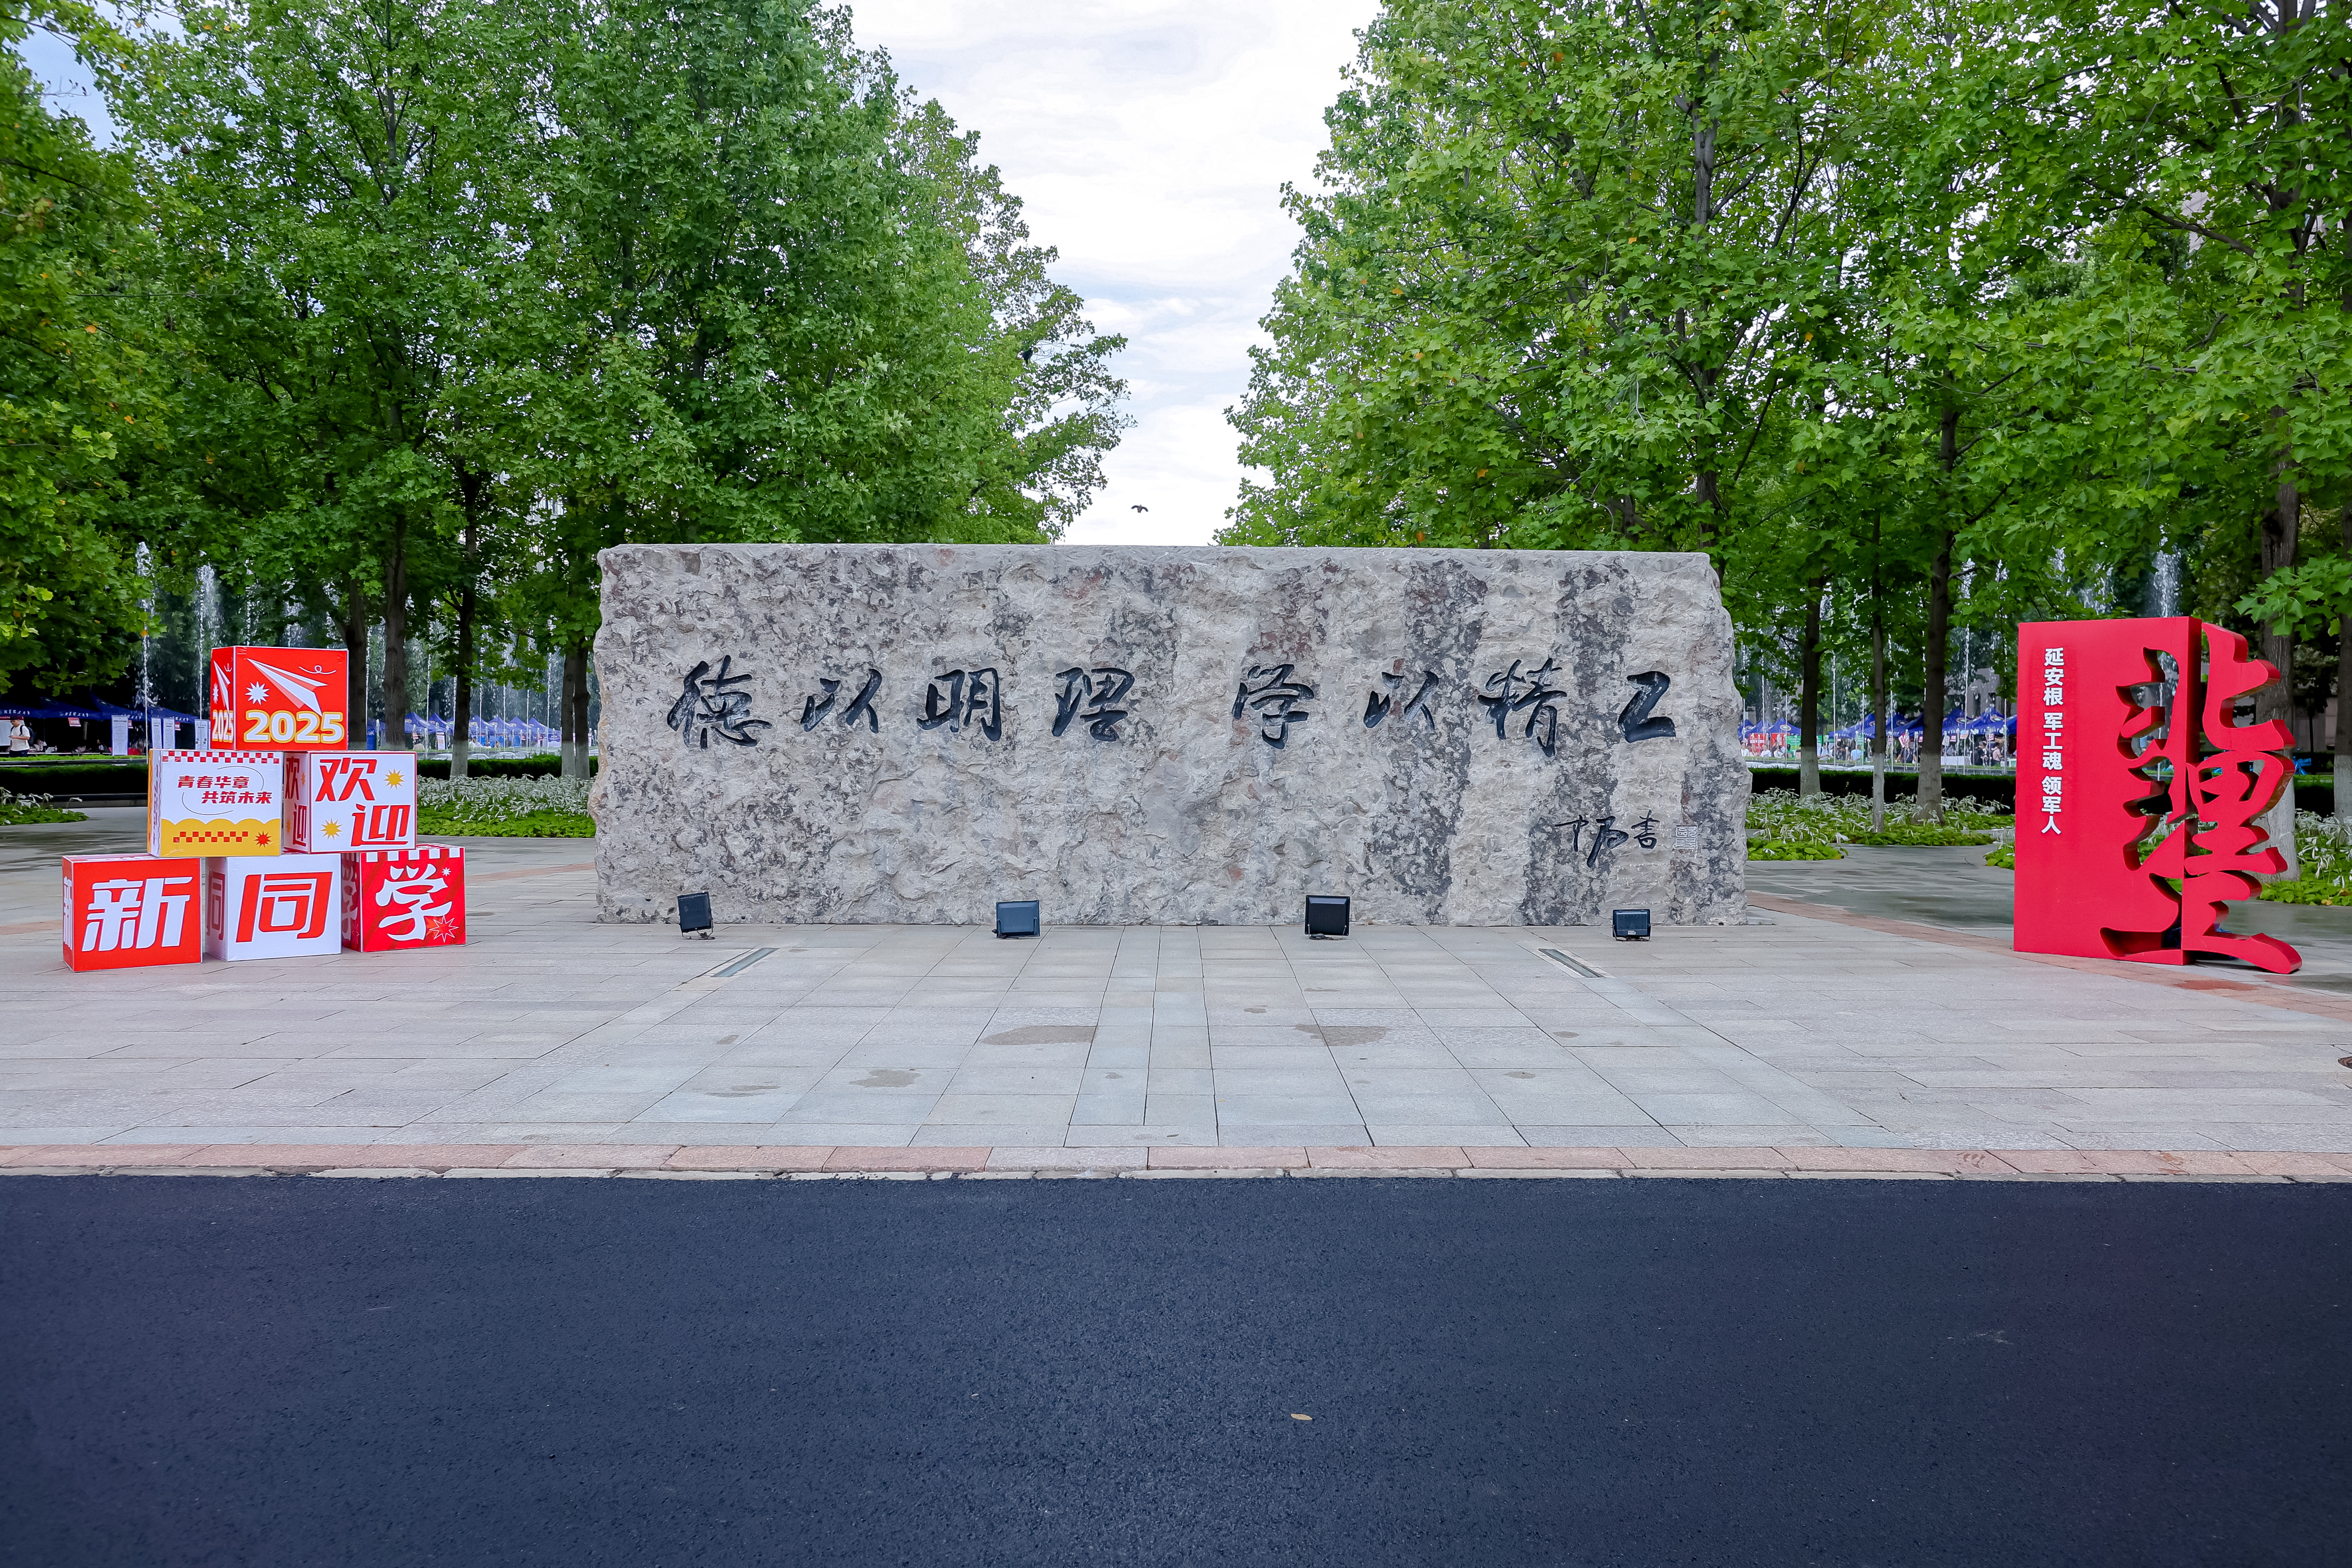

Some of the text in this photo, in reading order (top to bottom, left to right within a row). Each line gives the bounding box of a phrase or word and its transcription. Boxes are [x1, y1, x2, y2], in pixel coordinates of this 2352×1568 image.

[212, 709, 233, 743] 2025
[243, 710, 345, 743] 2025
[667, 654, 1675, 758] 德以明理 学以精工
[2041, 647, 2065, 835] 延安根 军工魂 领军人
[177, 775, 249, 789] 青春华章
[201, 791, 273, 804] 共筑未来
[315, 757, 377, 802] 欢
[351, 803, 411, 846] 迎
[81, 876, 193, 952] 新
[236, 871, 333, 942] 同
[375, 863, 453, 941] 学
